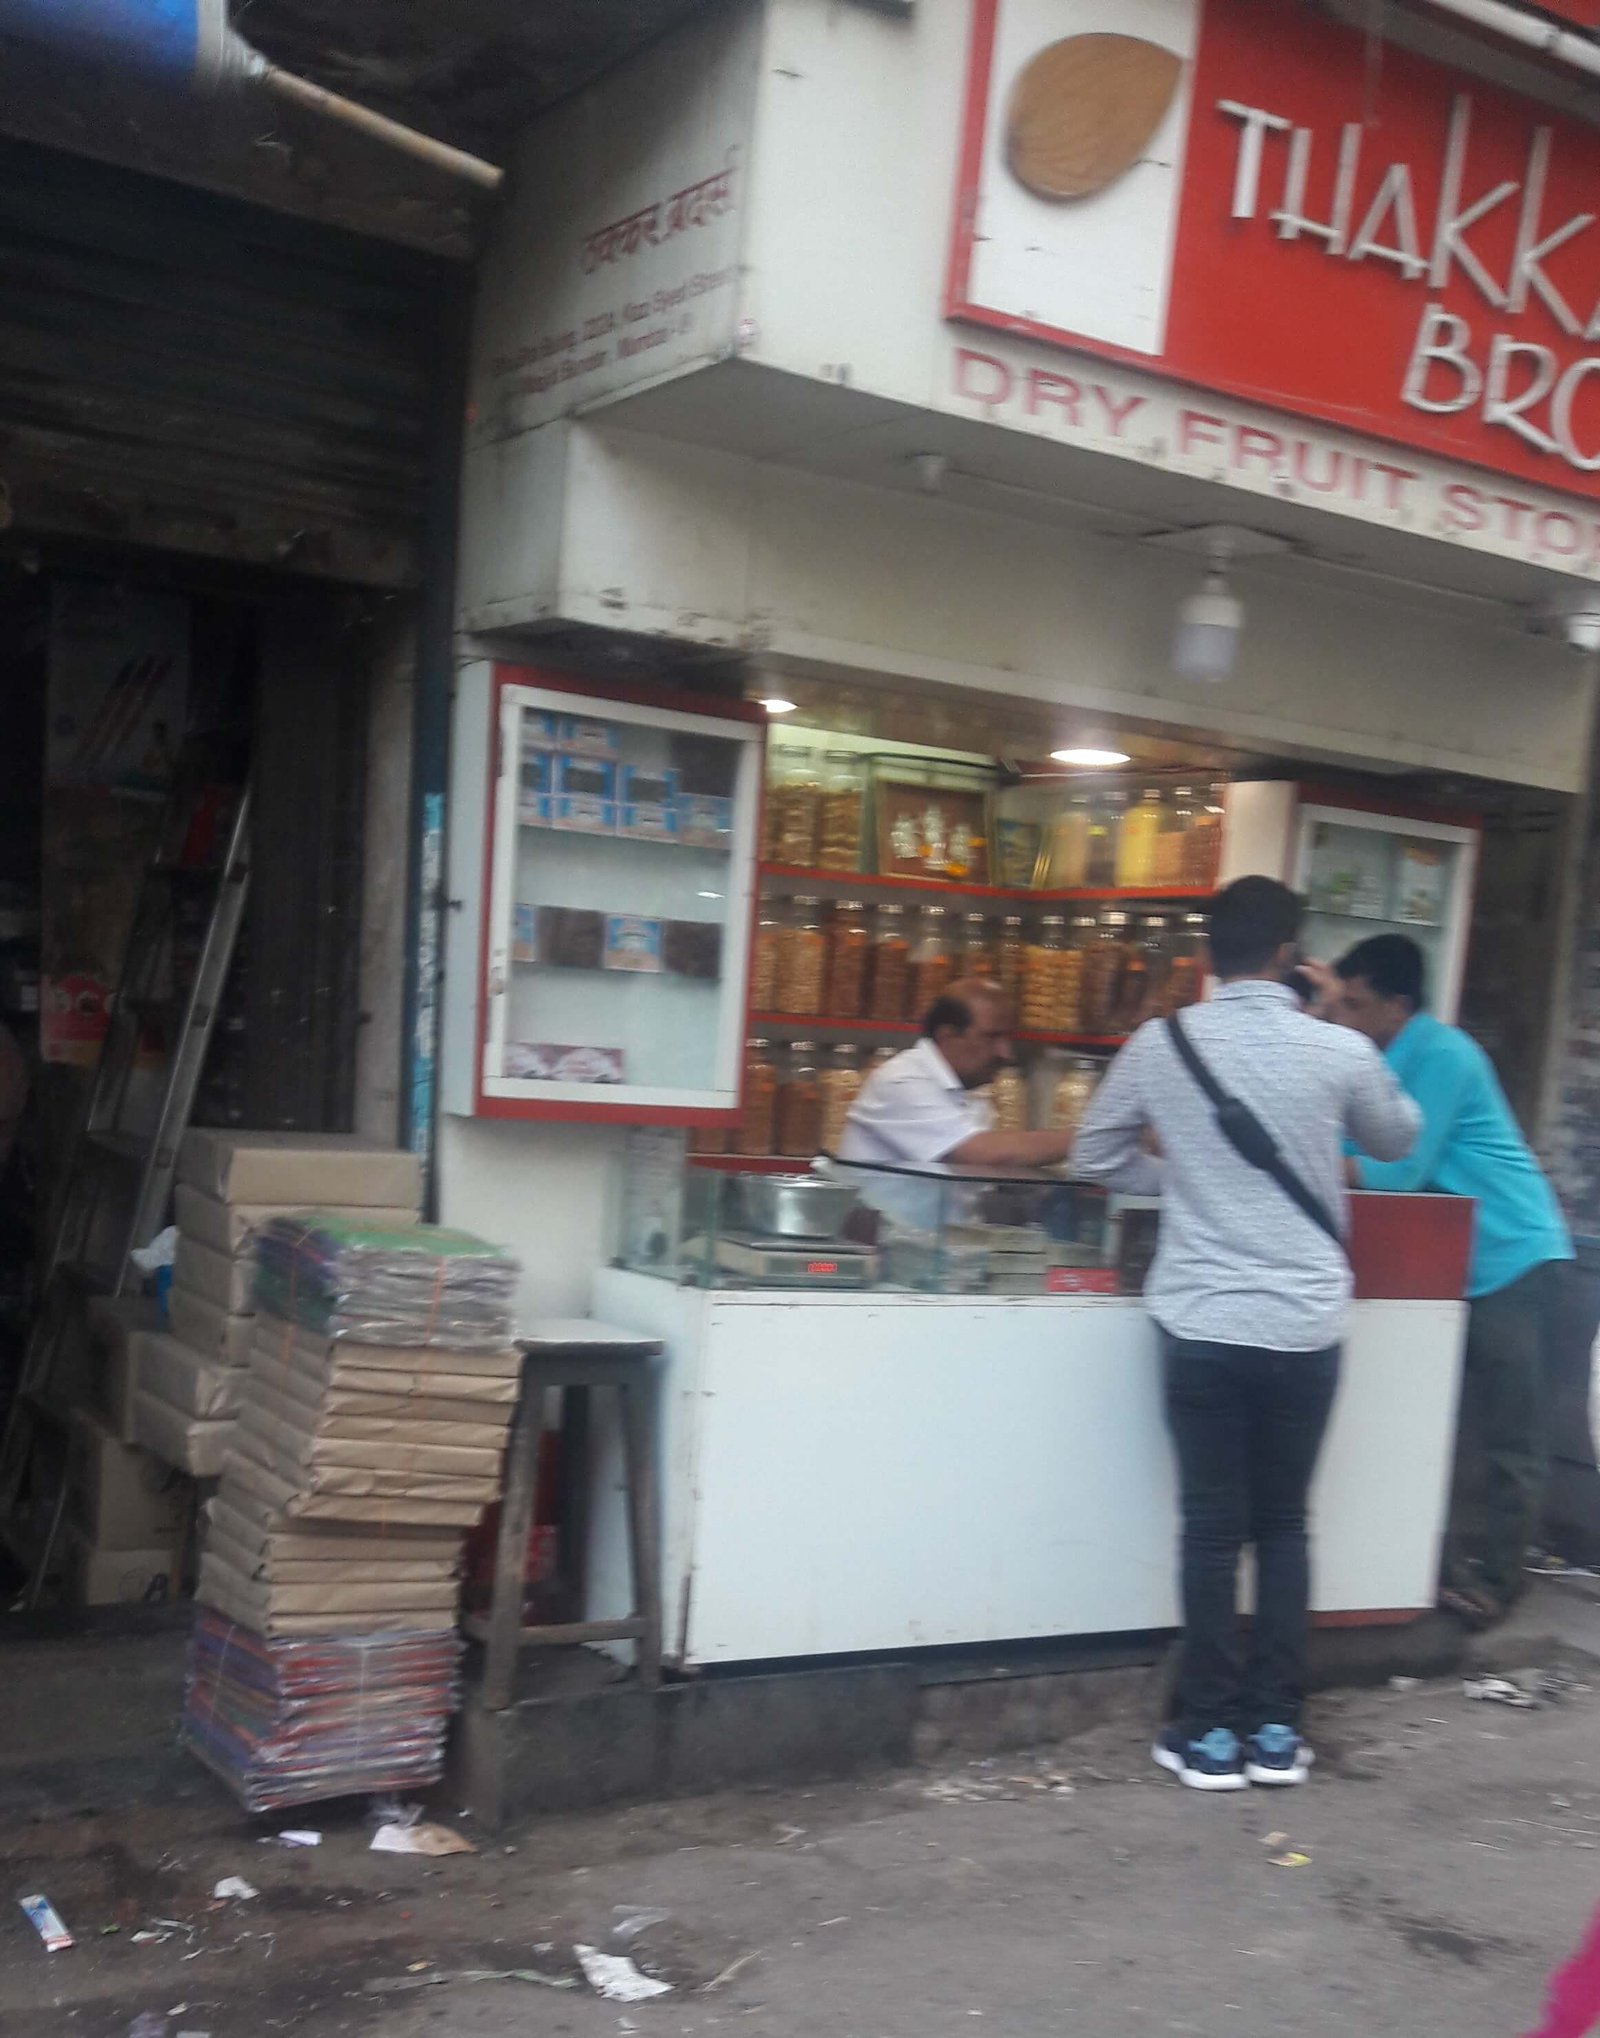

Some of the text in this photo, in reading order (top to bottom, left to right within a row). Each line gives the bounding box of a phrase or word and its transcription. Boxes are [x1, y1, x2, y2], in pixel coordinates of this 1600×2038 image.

[1217, 94, 1600, 341] THAKK
[952, 346, 1600, 562] DRY FRUIT STO
